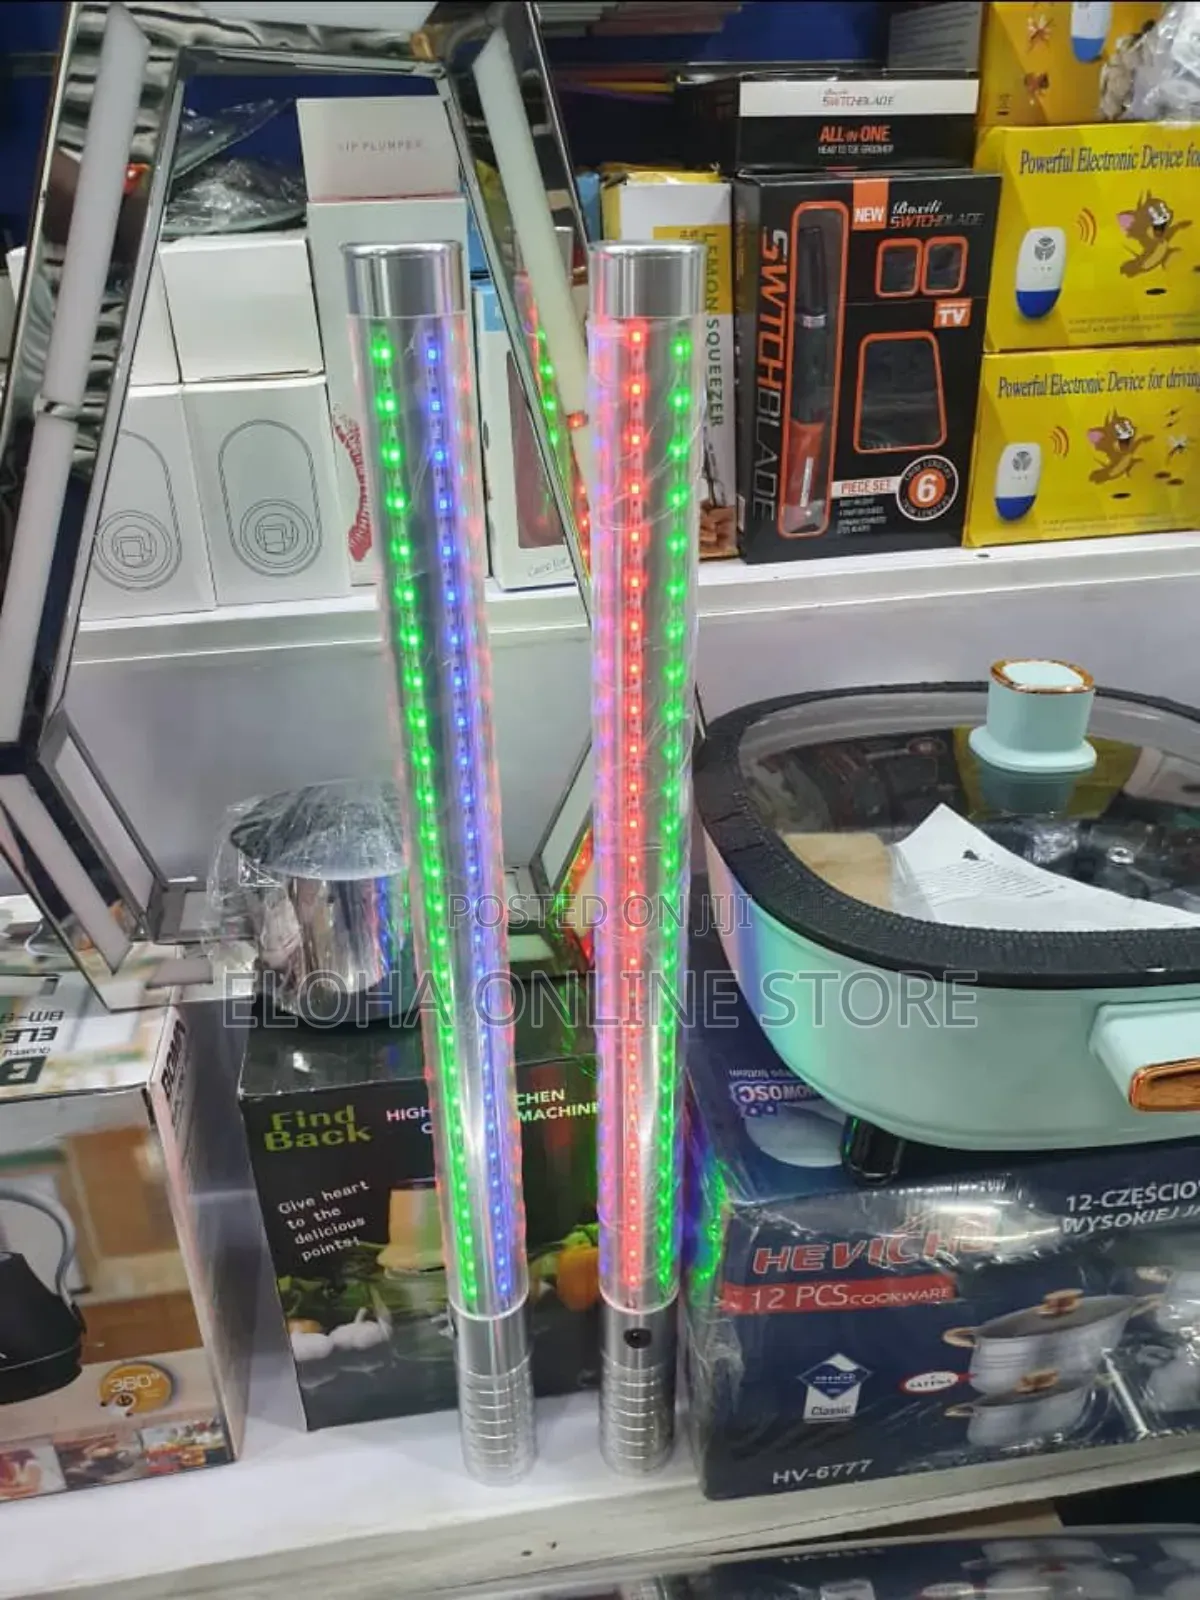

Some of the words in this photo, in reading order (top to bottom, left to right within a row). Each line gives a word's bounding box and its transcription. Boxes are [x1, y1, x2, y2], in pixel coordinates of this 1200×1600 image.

[820, 126, 844, 142] ALL
[861, 125, 891, 142] ONE
[1020, 148, 1074, 175] Powerful
[1077, 146, 1139, 173] Electronic
[1141, 143, 1183, 170] Device
[855, 207, 885, 223] NEW
[703, 231, 720, 317] LEMON
[938, 308, 966, 326] TV
[706, 318, 723, 427] SQUEEZER
[998, 374, 1047, 399] Powerful
[1051, 371, 1105, 396] Electronic
[1107, 369, 1145, 392] Device
[1148, 367, 1166, 390] for
[917, 473, 938, 503] 6
[0, 1026, 58, 1044] ELE
[271, 1104, 356, 1131] Find
[386, 1106, 432, 1121] HIGH
[514, 1088, 565, 1106] CHEN
[264, 1122, 373, 1151] Back
[278, 1196, 316, 1214] Give
[321, 1179, 370, 1202] heart
[1066, 1179, 1200, 1212] 12-CZĘŚCIO
[286, 1217, 306, 1230] to
[313, 1206, 342, 1222] the
[294, 1216, 366, 1245] delicious
[1062, 1205, 1180, 1234] WYSOKIEJ
[752, 1286, 786, 1310] 12
[796, 1284, 849, 1308] PCS
[811, 1405, 852, 1416] Classic
[772, 1459, 874, 1485] HV-6777
